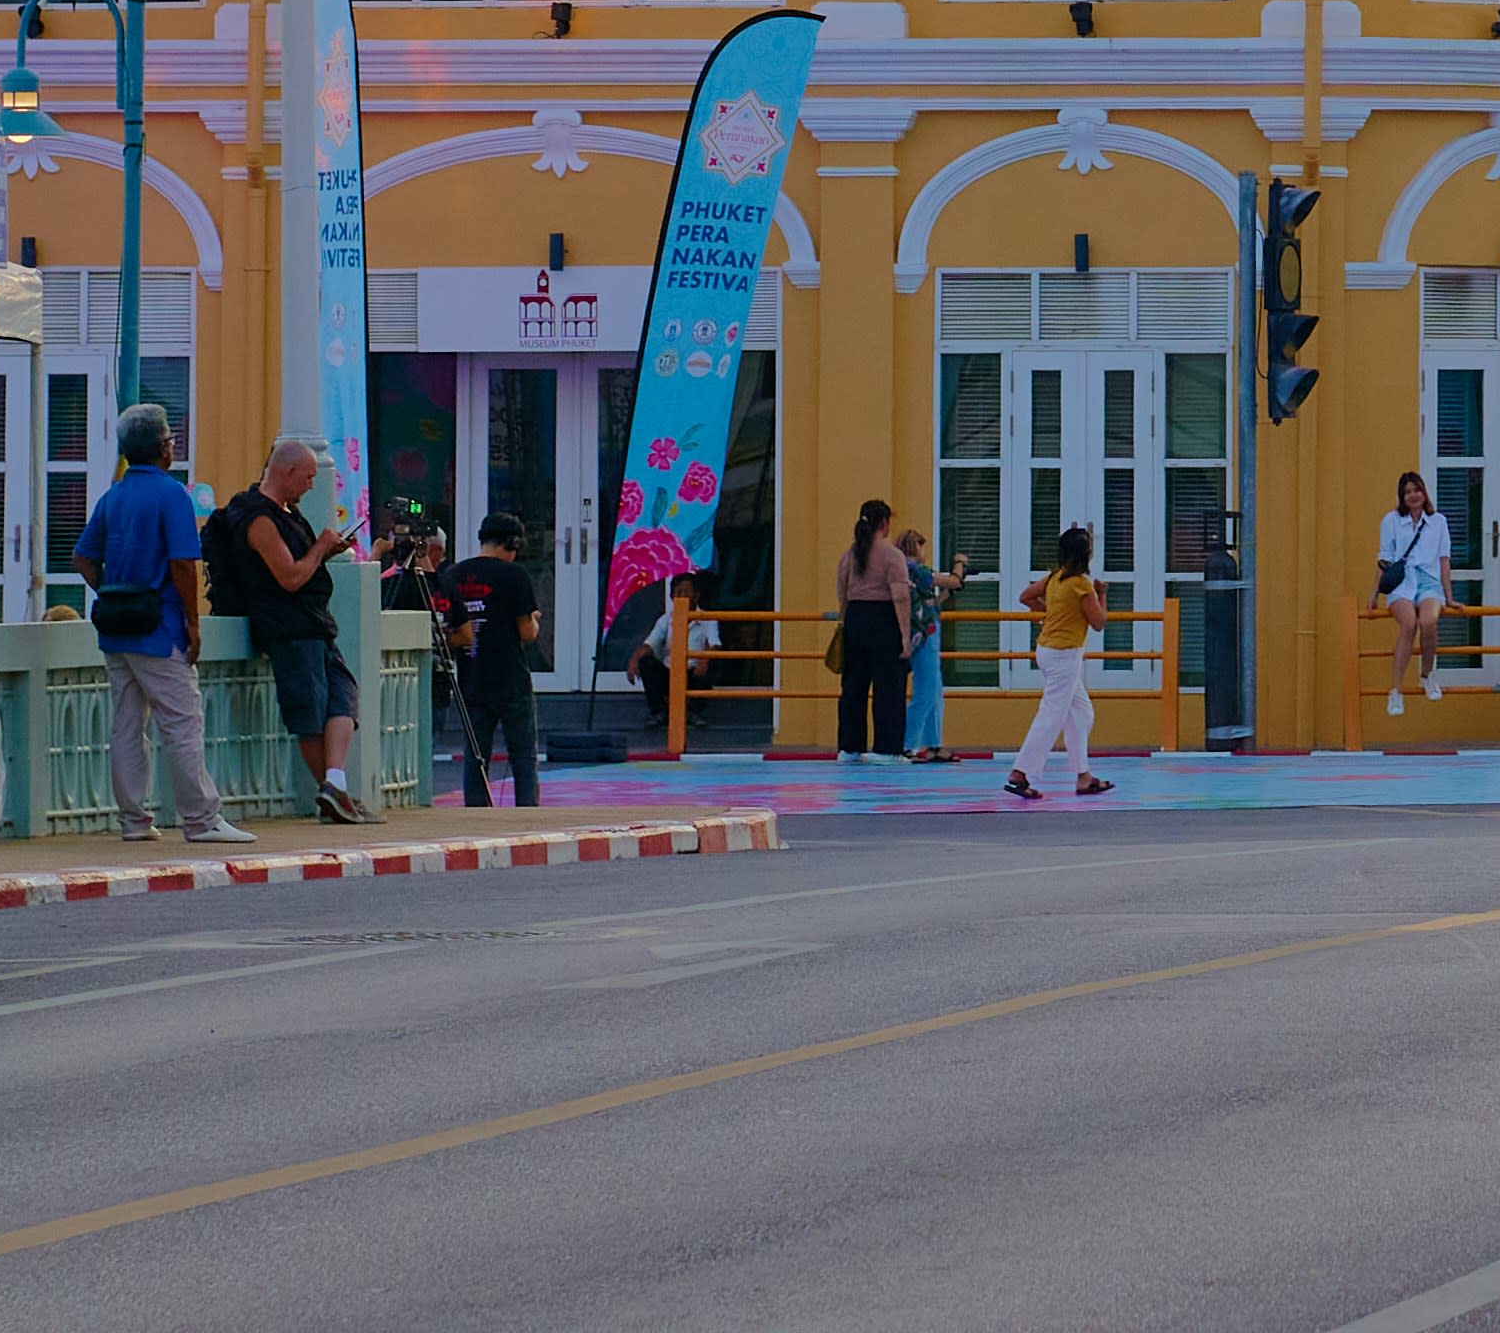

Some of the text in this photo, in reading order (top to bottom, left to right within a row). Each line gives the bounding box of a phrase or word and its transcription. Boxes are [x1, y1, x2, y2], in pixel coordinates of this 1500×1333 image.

[680, 201, 767, 223] PHUKET
[676, 225, 729, 244] PERA
[672, 247, 756, 269] NAKAN
[667, 270, 749, 293] FESTIVA
[519, 338, 597, 348] MUSEUM PHUKET
